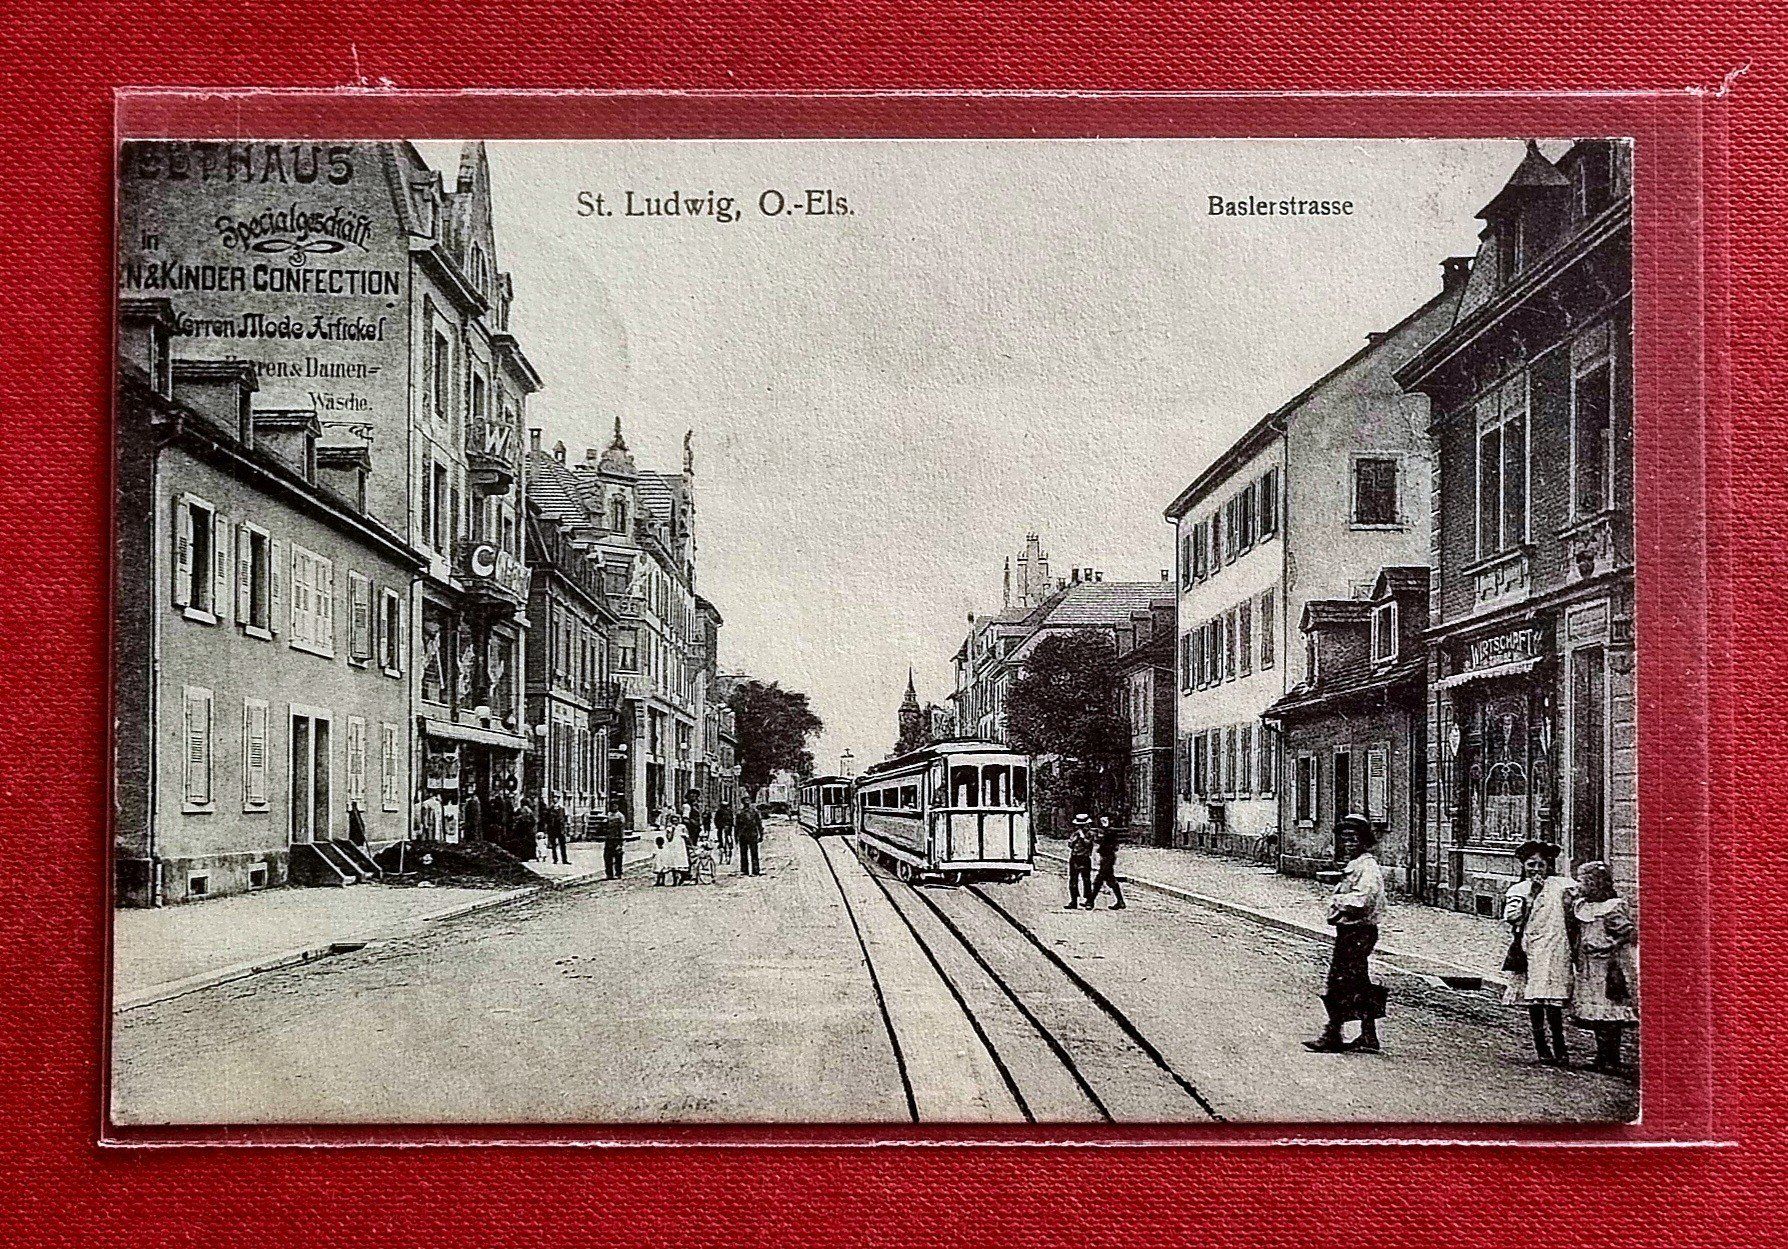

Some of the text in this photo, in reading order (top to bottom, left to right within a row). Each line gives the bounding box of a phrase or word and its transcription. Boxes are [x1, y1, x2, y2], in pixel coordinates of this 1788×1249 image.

[576, 189, 855, 223] St. Ludwig, O.-Els.
[1207, 195, 1354, 216] Baslerstrasse
[141, 230, 159, 251] in
[253, 263, 400, 296] CONFECTION
[237, 313, 307, 340] Mode
